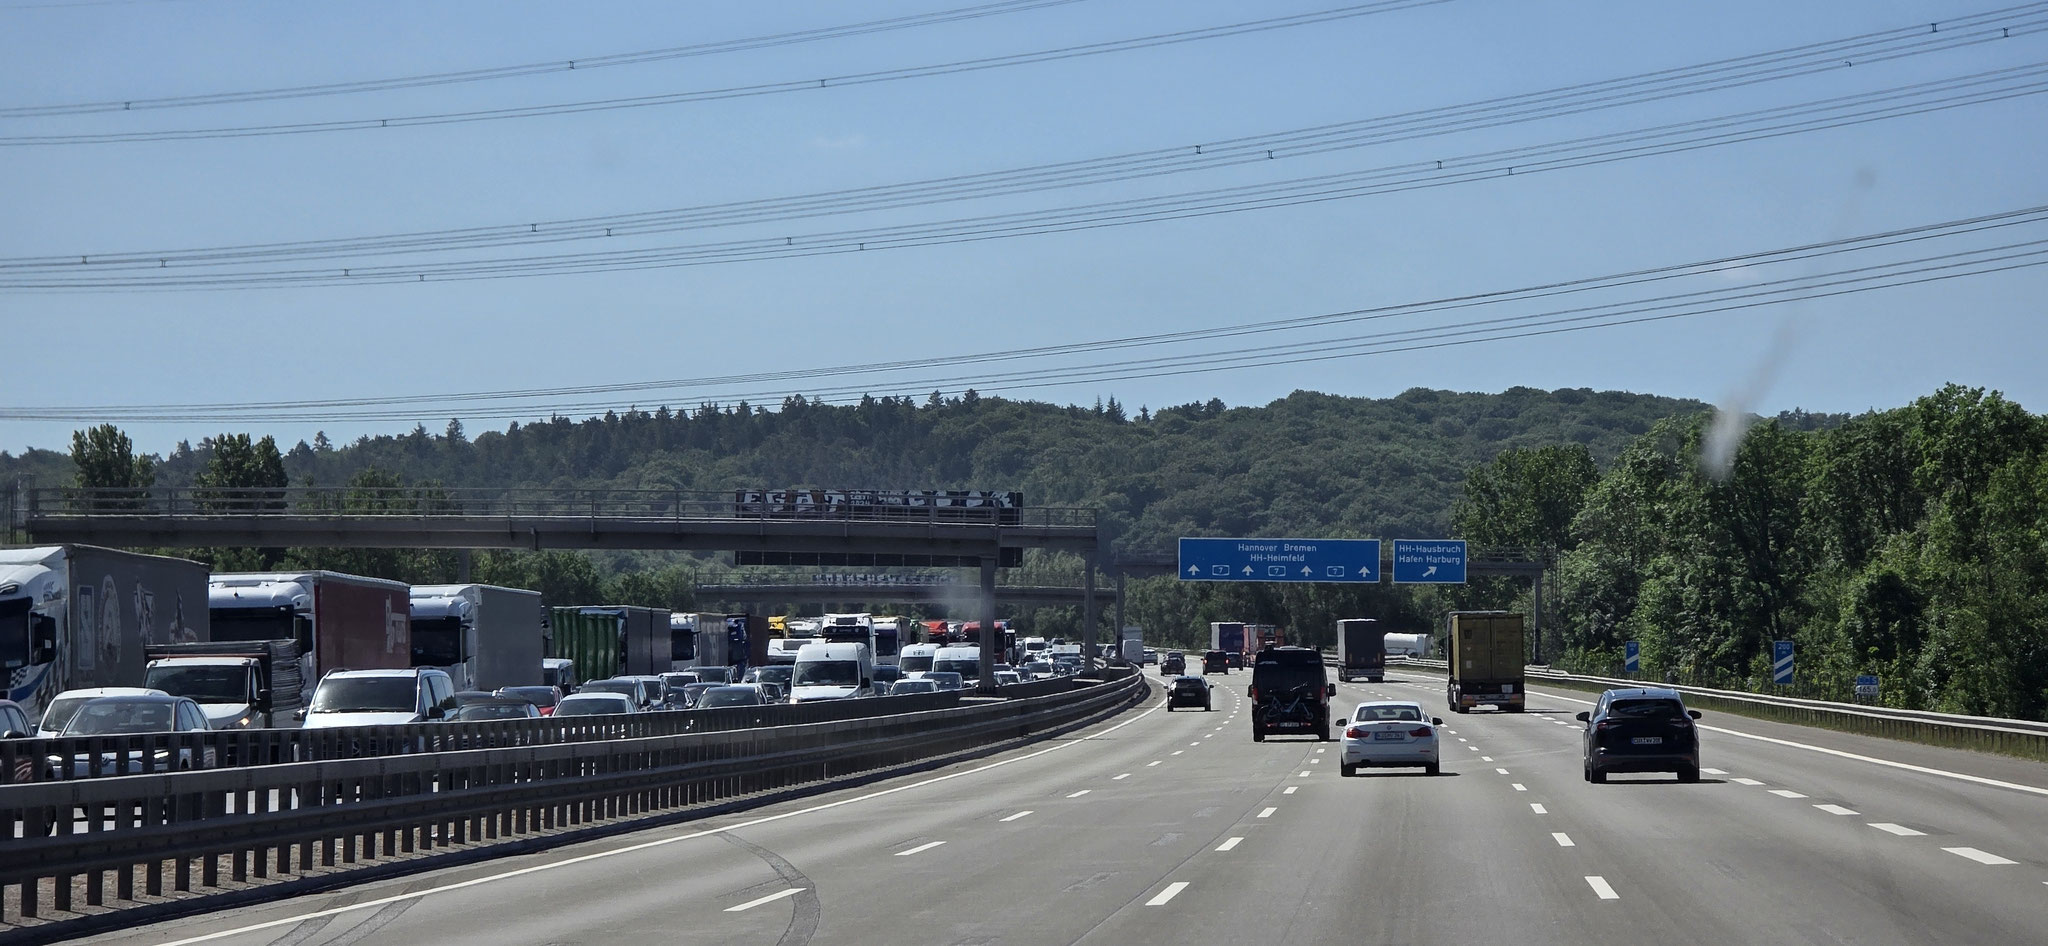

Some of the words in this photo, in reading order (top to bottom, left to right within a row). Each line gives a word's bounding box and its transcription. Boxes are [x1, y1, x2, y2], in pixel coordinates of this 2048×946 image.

[1238, 544, 1278, 552] Hannover
[1284, 544, 1317, 552] Bremen
[1399, 545, 1461, 553] HH-Hausbruch
[1250, 554, 1305, 562] HH-Heimfeld
[1399, 555, 1423, 563] Hafen
[1426, 556, 1461, 565] Harburg
